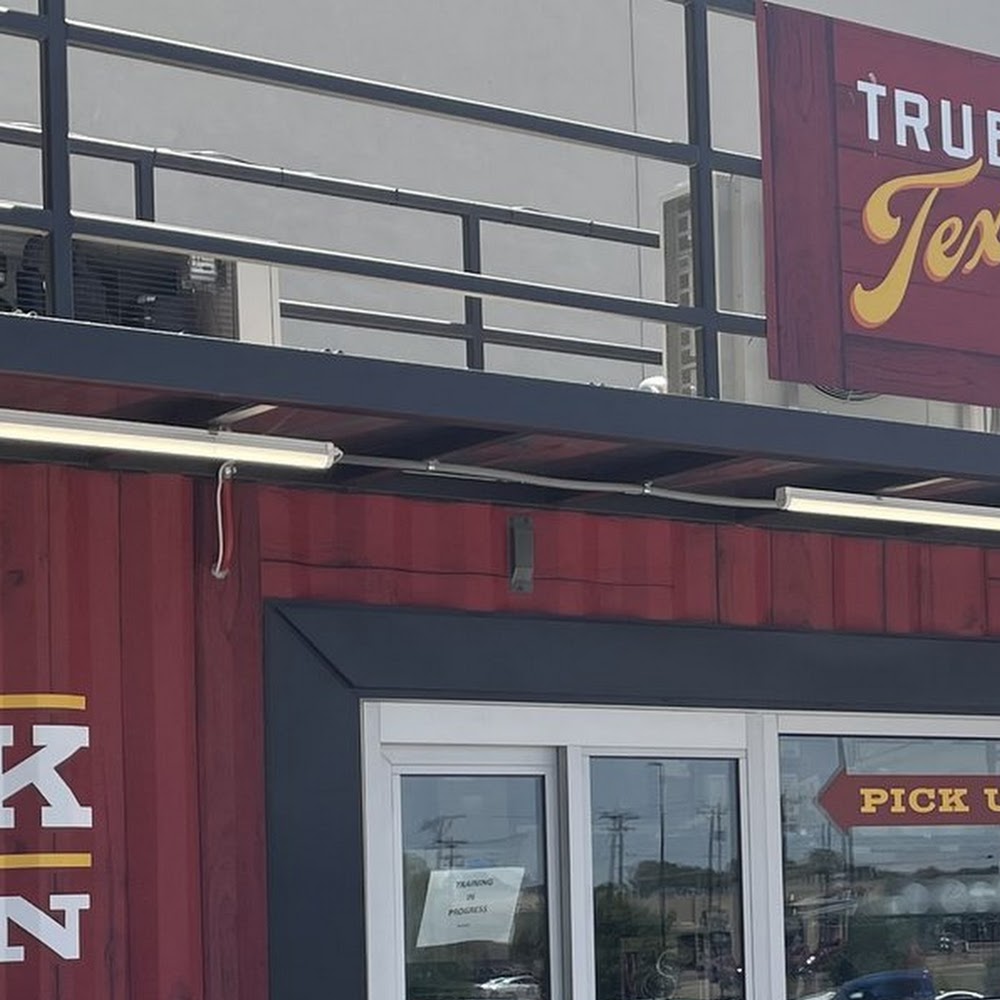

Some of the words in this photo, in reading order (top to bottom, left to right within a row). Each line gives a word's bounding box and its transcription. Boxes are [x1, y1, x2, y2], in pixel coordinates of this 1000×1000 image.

[860, 787, 970, 813] PICK
[455, 878, 494, 889] TRAINING
[466, 893, 475, 901] IN
[447, 905, 488, 917] PROGRESS
